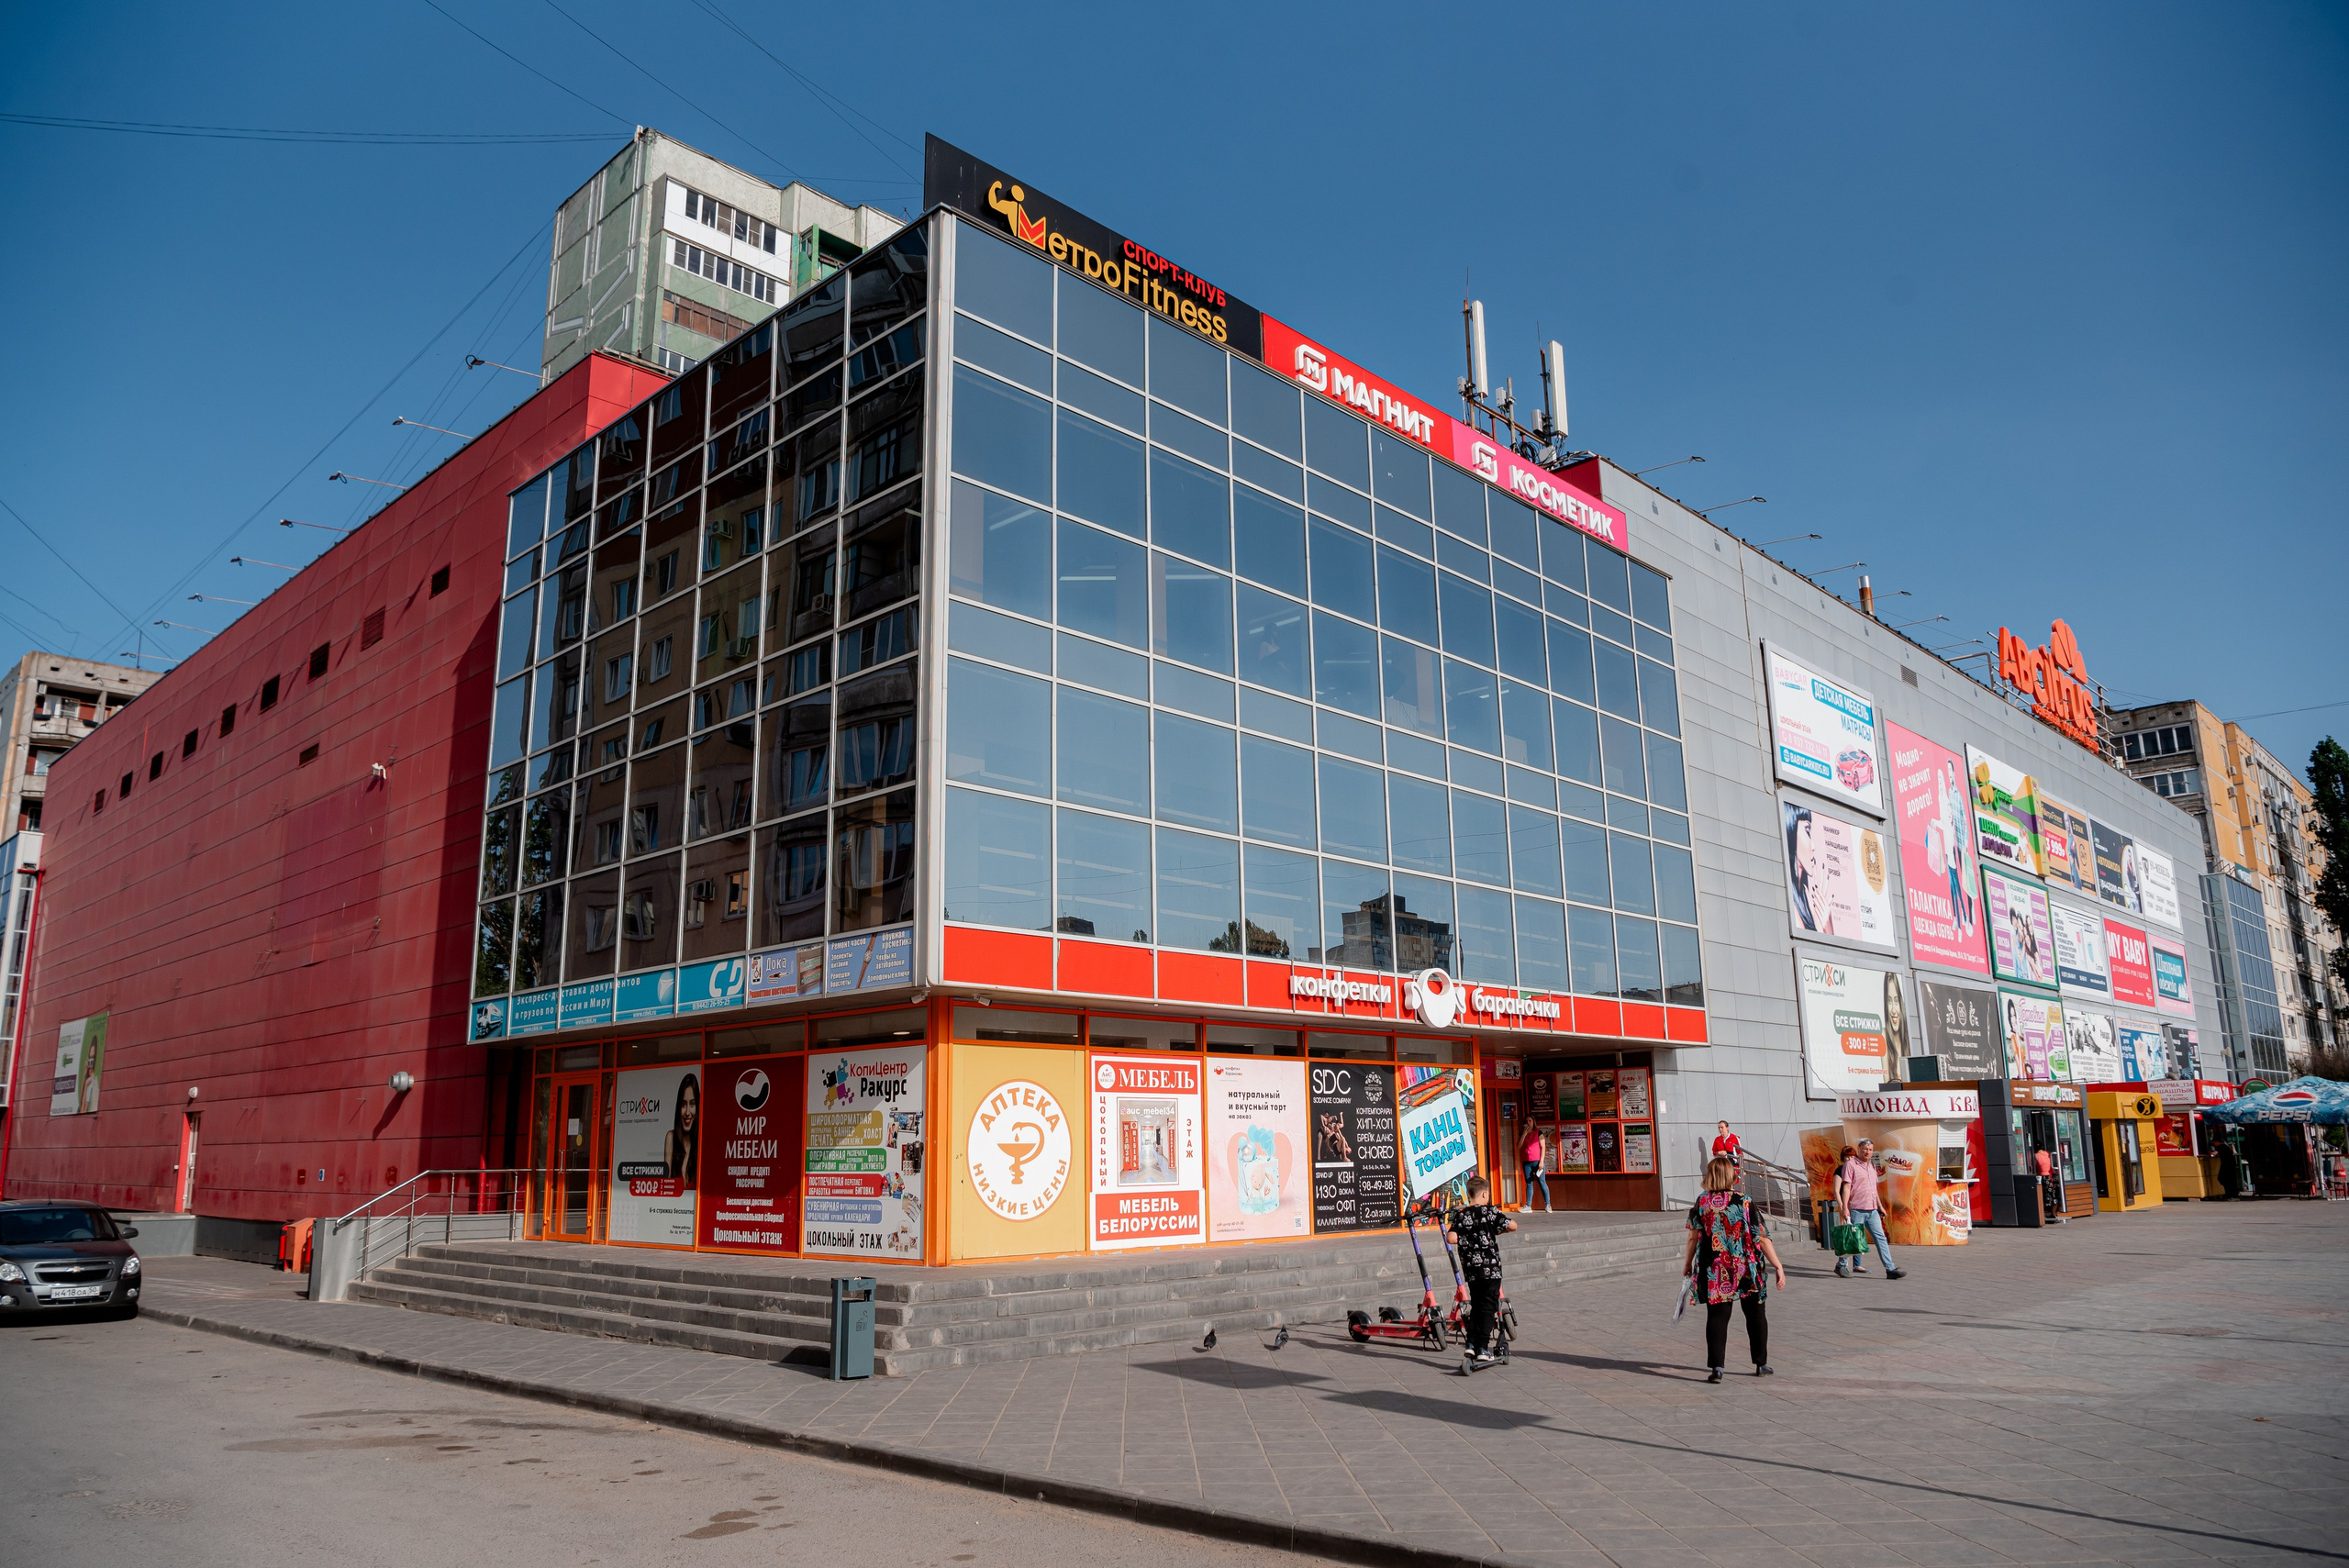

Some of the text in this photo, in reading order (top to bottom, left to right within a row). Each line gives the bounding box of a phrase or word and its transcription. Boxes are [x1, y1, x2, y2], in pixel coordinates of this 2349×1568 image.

[1123, 239, 1227, 307] СПОРТ-КЛУБ
[1331, 367, 1434, 444] МАГНИТ
[1508, 465, 1615, 542] КОСМЕТИК
[1775, 666, 1808, 685] BABYCAR
[1814, 682, 1870, 721] ДЕТСКАЯ МЕБЕЛЬ
[1841, 714, 1873, 742] МАТРАСЫ
[1895, 749, 1919, 768] Модно
[1898, 768, 1932, 793] не значит
[1907, 794, 1933, 818] дорого!
[1909, 887, 1953, 920] ГАЛАКТИКА
[1914, 916, 1954, 940] ОДЕЖДА ОБУВЬ
[830, 938, 867, 951] Ремонт часов
[2106, 930, 2121, 960] MY
[2121, 936, 2147, 967] BABY
[765, 957, 787, 972] Дока
[1290, 972, 1391, 1006] конфетки
[519, 1009, 544, 1020] грузов
[590, 998, 611, 1010] Миру
[1472, 987, 1560, 1019] бараночки
[1835, 1015, 1881, 1031] ВСЕ СТРИЖКИ
[850, 1062, 908, 1078] КопиЦентр
[1119, 1068, 1195, 1089] МЕБЕЛЬ
[1312, 1068, 1351, 1095] SDC
[860, 1077, 907, 1103] Ракурс
[1228, 1089, 1281, 1101] натуральный
[979, 1086, 1061, 1133] АПТЕКА
[1235, 1102, 1269, 1113] вкусный
[1271, 1105, 1287, 1113] торт
[1356, 1107, 1393, 1116] КОНТЕМПОРАРИ
[1841, 1097, 1931, 1116] ЛИМОНАД
[810, 1112, 873, 1127] ШИРОКОФОРМАТНАЯ
[2257, 1110, 2312, 1121] PEPSI
[736, 1116, 767, 1136] МИР
[1356, 1118, 1393, 1130] ХИП-ХОП
[1409, 1106, 1463, 1155] КАНЦ
[810, 1134, 834, 1147] ПЕЧАТЬ
[833, 1126, 883, 1140] БАННЕР ХОЛСТ
[1099, 1095, 1108, 1186] ЦОКОЛЬНЫЙ
[1186, 1118, 1194, 1158] ЭТАЖ
[1357, 1132, 1375, 1142] БРЕЙК
[725, 1140, 778, 1159] МЕБЕЛИ
[809, 1151, 846, 1161] ОПЕРАТИВНАЯ
[868, 1154, 879, 1162] ФОТО
[879, 1154, 885, 1162] НА
[1358, 1145, 1395, 1160] CHOREO
[1415, 1135, 1466, 1177] ТОВАРЫ
[622, 1166, 664, 1175] ВСЕ СТРИЖКИ
[728, 1166, 770, 1177] СКИДКИ! КРЕДИТ!
[809, 1162, 885, 1171] ПОЛИГРАФИЯ ВИЗИТКИ ДОКУМЕНТЫ
[735, 1178, 764, 1188] РАССРОЧКА!
[808, 1176, 844, 1186] ПОСТПЕЧАТНАЯ
[1337, 1171, 1355, 1184] КВН
[1362, 1180, 1393, 1191] 98-49-88
[808, 1187, 831, 1195] ОБРАБОТКА
[973, 1159, 1068, 1217] НИЗКИЕ ЦЕНЫ
[1315, 1184, 1337, 1199] ИЗО
[726, 1197, 774, 1207] Бесплатная доставка!
[807, 1201, 840, 1211] СУВЕНИРНАЯ
[1119, 1197, 1179, 1214] МЕБЕЛЬ
[1336, 1199, 1355, 1212] ОФП
[716, 1211, 785, 1223] Профессиональная сборка!
[807, 1212, 829, 1221] ПРОДУКЦИЯ
[844, 1213, 871, 1223] КАЛЕНДАРИ
[1379, 1209, 1392, 1218] ЭТАЖ
[1099, 1214, 1198, 1234] БЕЛОРУССИИ
[1317, 1217, 1356, 1227] КАЛЛИГРАФИЯ
[714, 1227, 783, 1245] Цокольный этаж
[807, 1228, 883, 1250] ЦОКОЛЬНЫЙ ЭТАЖ
